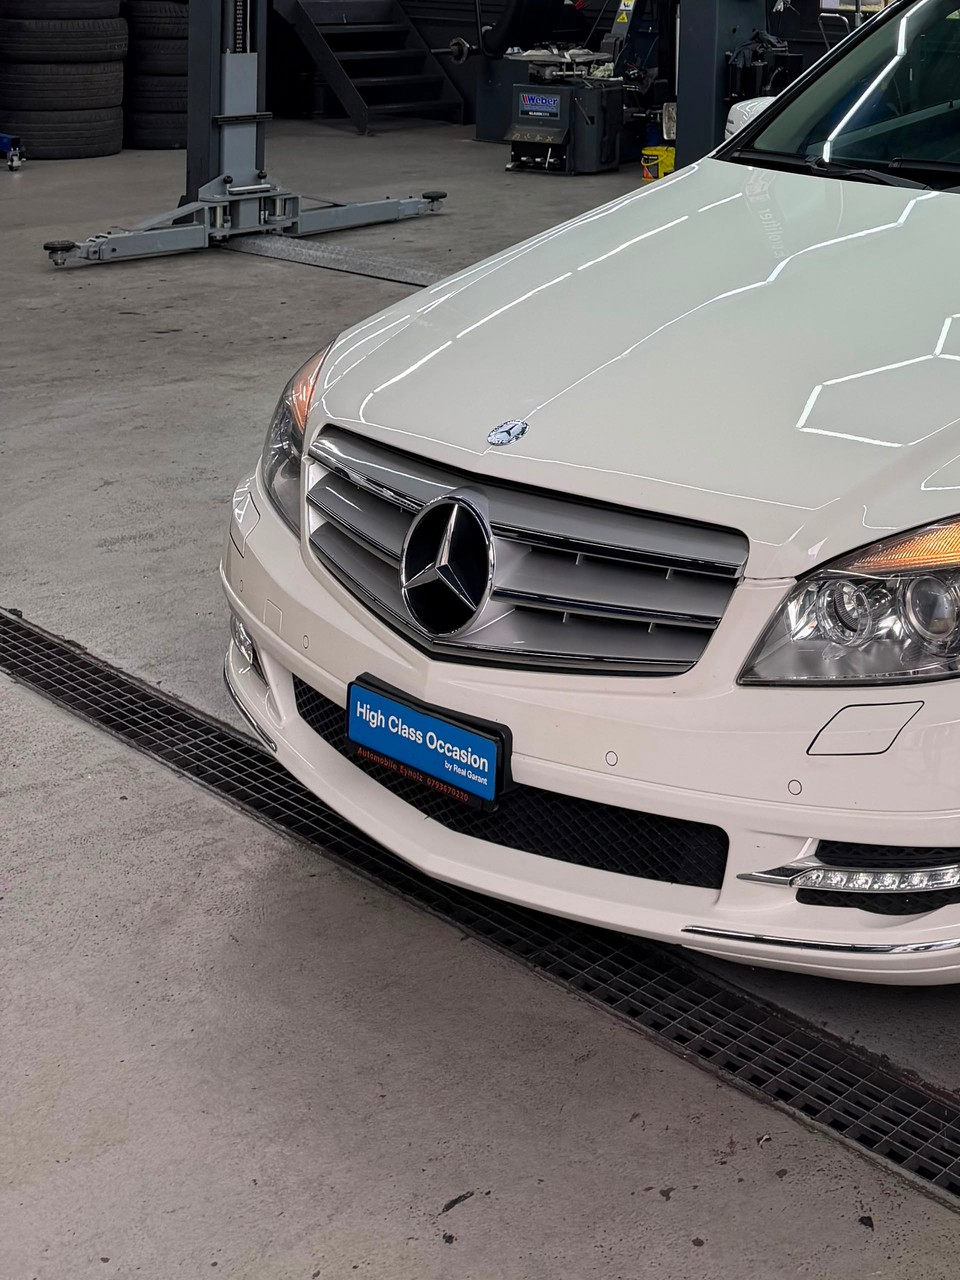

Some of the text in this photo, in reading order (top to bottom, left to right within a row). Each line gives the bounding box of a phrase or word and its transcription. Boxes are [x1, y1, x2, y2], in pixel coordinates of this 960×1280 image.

[525, 95, 558, 105] Weber
[356, 701, 489, 772] High Class Occasion
[357, 747, 398, 771] Automobile
[444, 760, 488, 786] by Real Garant
